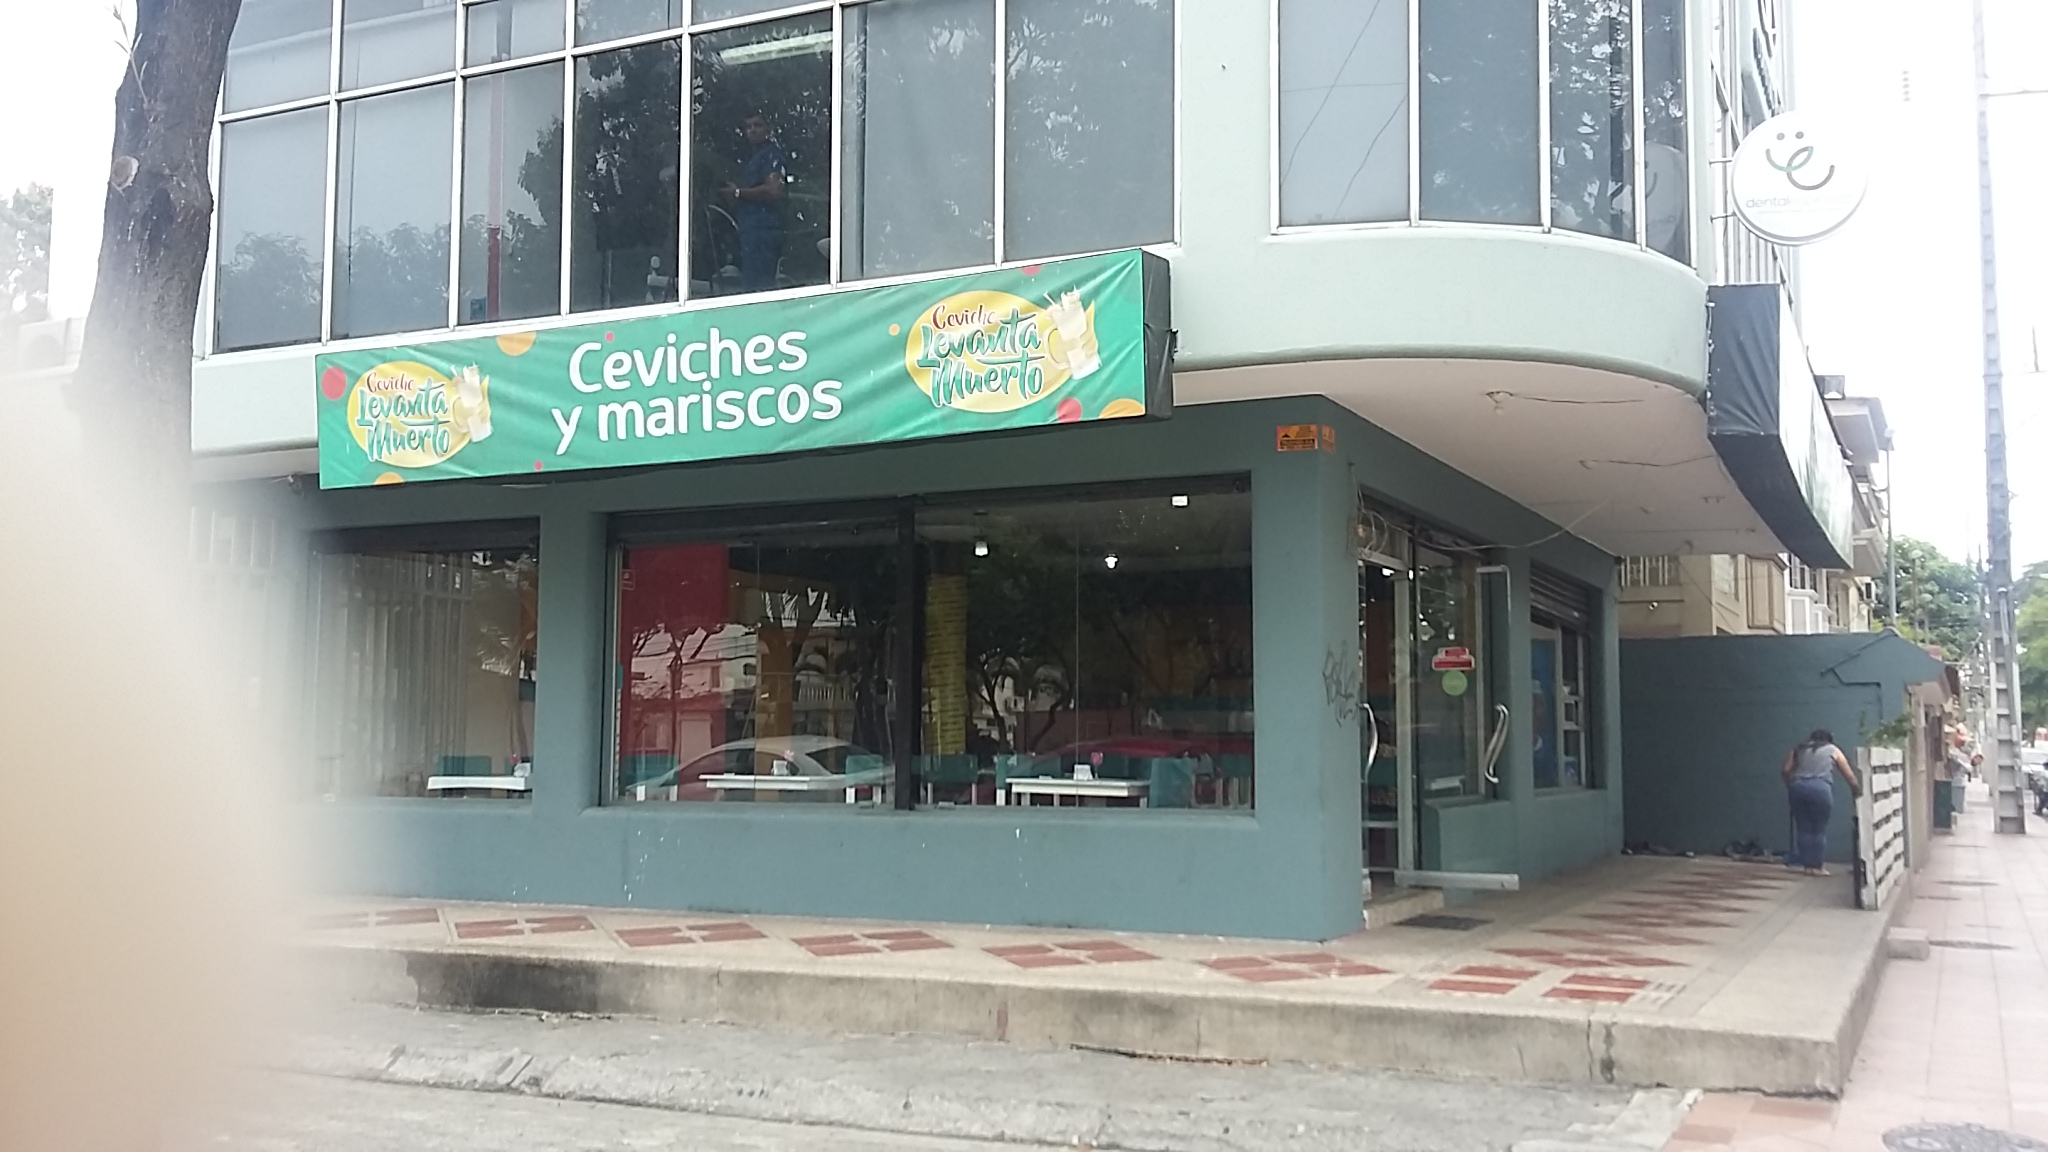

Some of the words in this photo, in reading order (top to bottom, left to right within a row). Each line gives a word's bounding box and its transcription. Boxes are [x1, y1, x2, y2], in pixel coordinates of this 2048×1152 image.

[916, 307, 1041, 368] Levanta
[932, 304, 996, 330] Ceviche
[366, 372, 414, 392] Ceviche
[569, 327, 808, 393] Ceviches
[931, 352, 1045, 407] Muerto
[356, 377, 448, 427] Levanta
[551, 405, 583, 456] y
[598, 380, 843, 441] mariscos
[366, 418, 451, 462] Muerto
